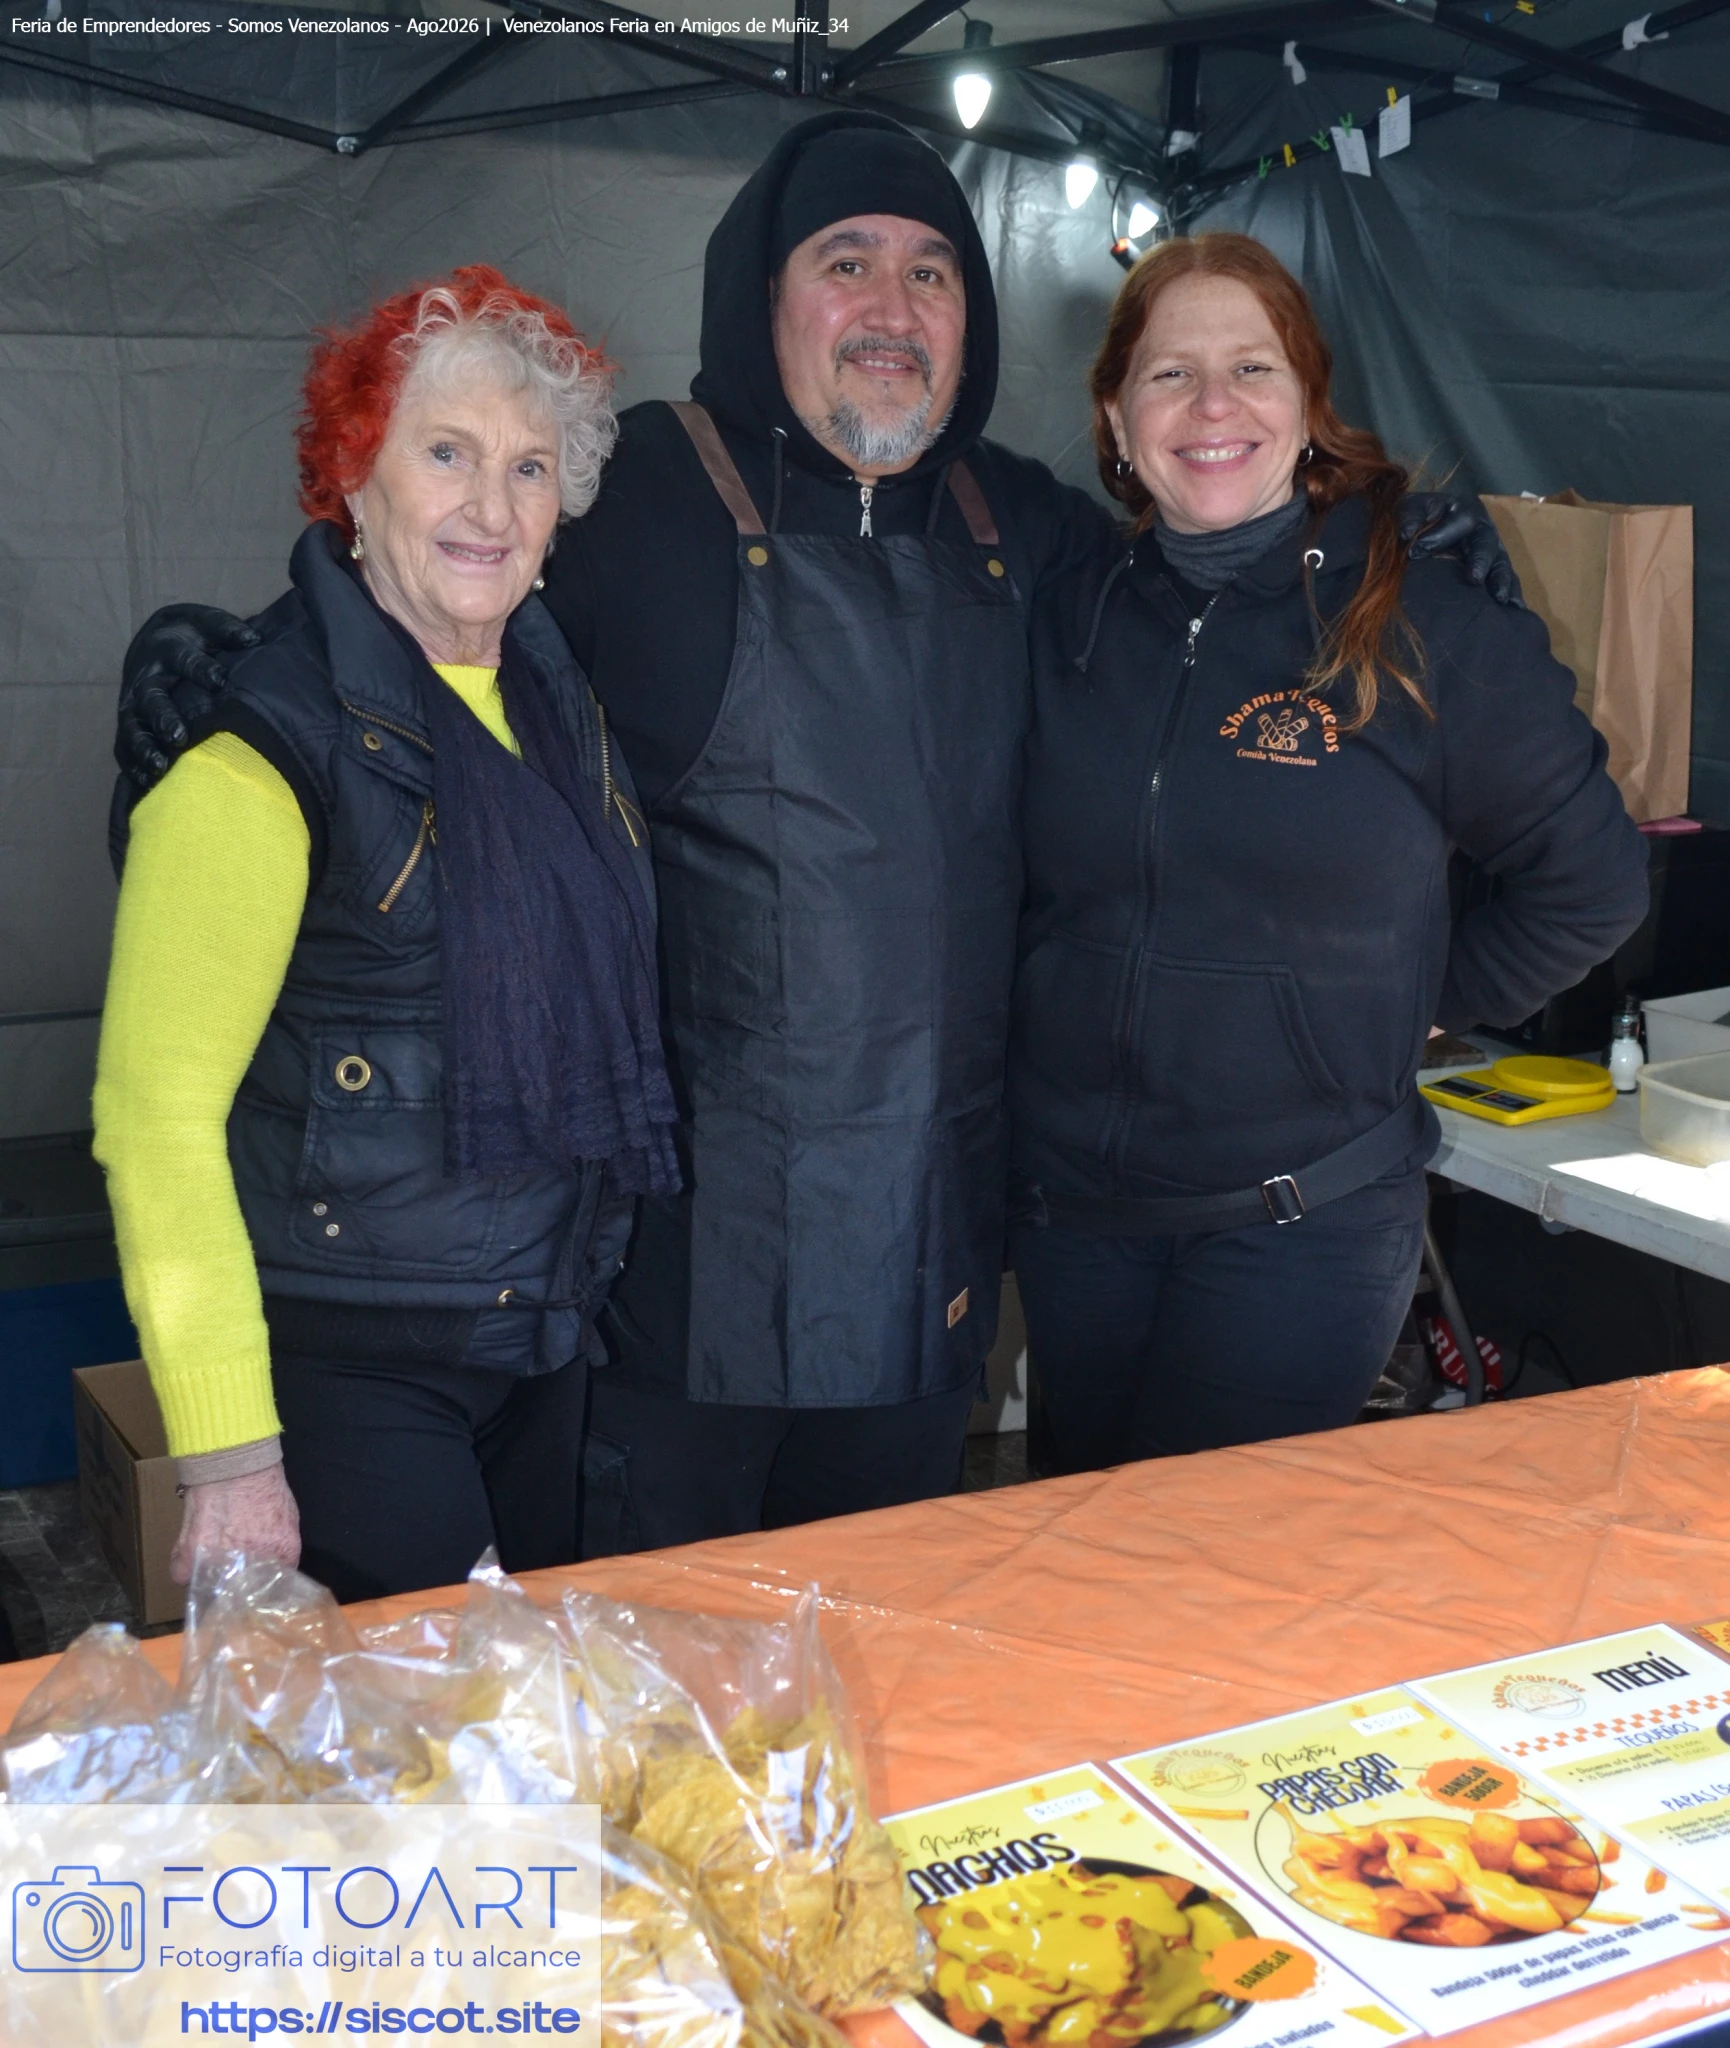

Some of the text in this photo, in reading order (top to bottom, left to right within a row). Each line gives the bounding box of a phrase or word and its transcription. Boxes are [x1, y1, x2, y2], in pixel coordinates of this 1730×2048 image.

[1237, 749, 1318, 767] Comida Venezolana
[1613, 1721, 1700, 1748] TEQUEÑOS
[1262, 1744, 1337, 1773] Nuestras
[1256, 1766, 1346, 1802] PAPAS
[1438, 1766, 1489, 1798] BANDEJA
[1463, 1776, 1504, 1802] 500GR
[1661, 1789, 1719, 1812] PAPAS
[919, 1824, 1001, 1857] Nuestras
[906, 1832, 1078, 1905] NACHOS
[1234, 1949, 1294, 1990] BANDEJA
[1430, 1974, 1486, 1998] Bandeja
[1523, 1956, 1544, 1969] de
[1542, 1943, 1584, 1964] papas
[1615, 1925, 1642, 1940] con
